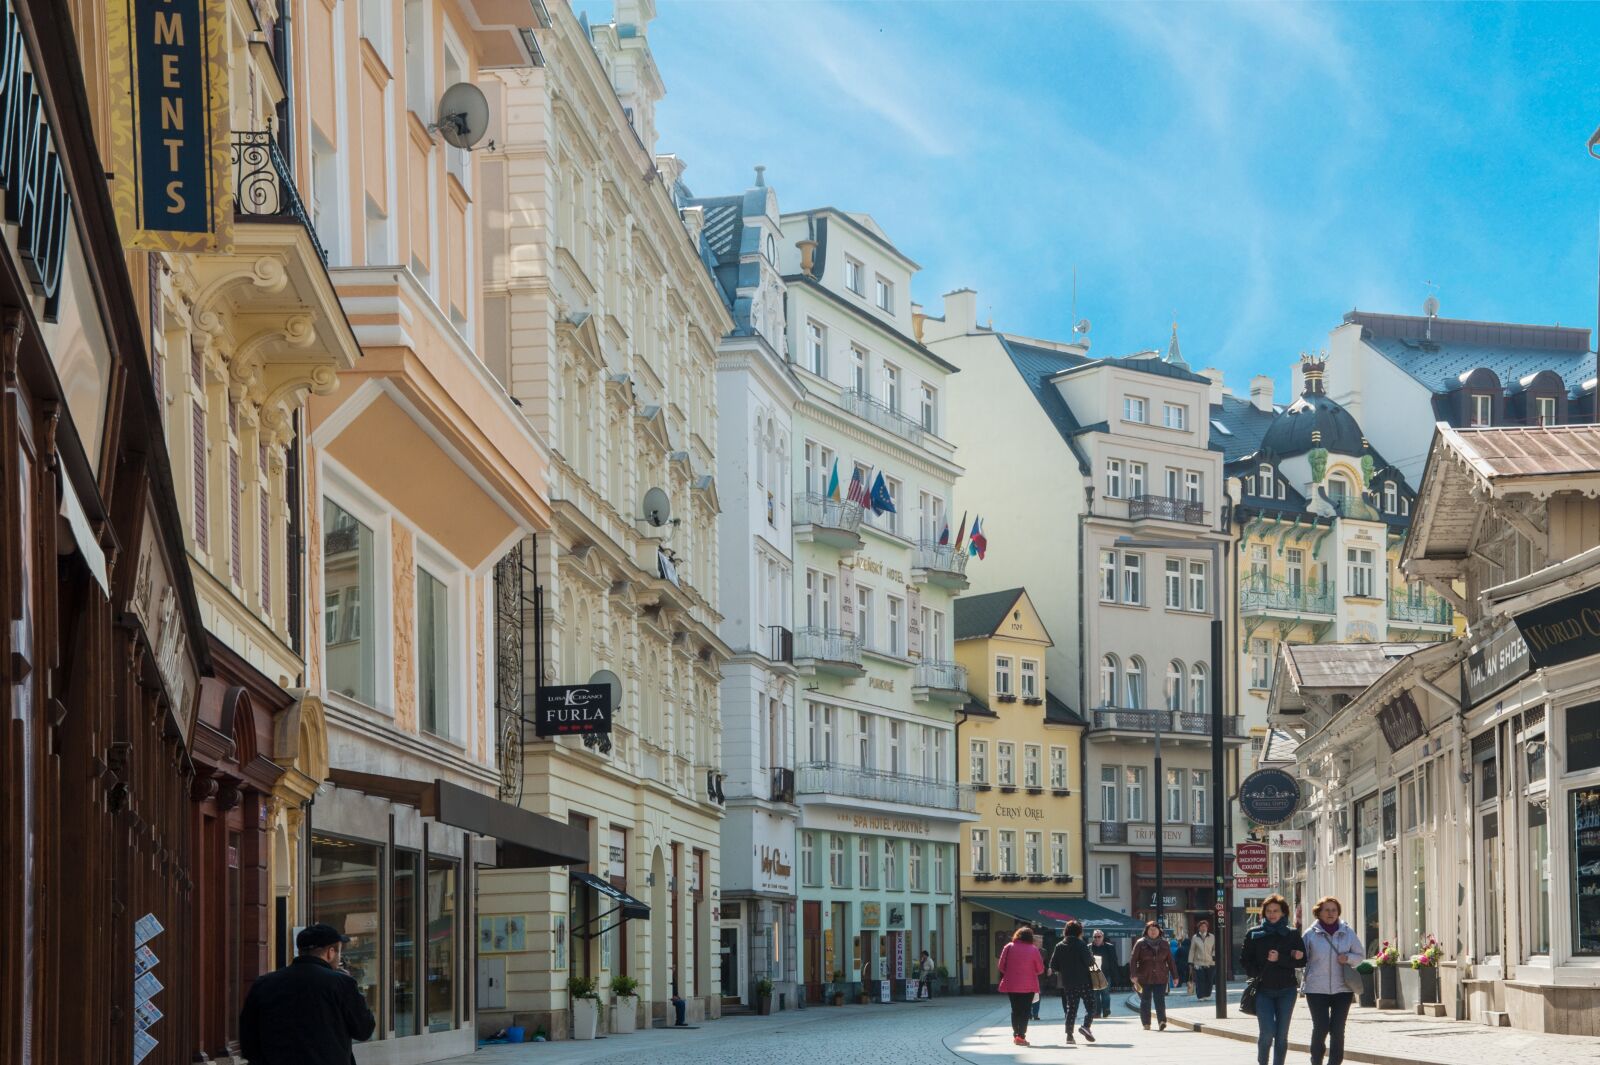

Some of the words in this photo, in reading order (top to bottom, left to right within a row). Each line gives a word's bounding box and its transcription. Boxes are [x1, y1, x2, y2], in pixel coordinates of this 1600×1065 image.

[153, 0, 186, 215] MENTS
[1523, 618, 1582, 652] WORLD
[1499, 636, 1528, 670] SHOES
[546, 708, 604, 721] FURLA
[853, 814, 868, 828] SPA
[870, 815, 891, 830] HOTEL
[995, 803, 1021, 819] ČERNÝ
[1024, 806, 1045, 821] OREL
